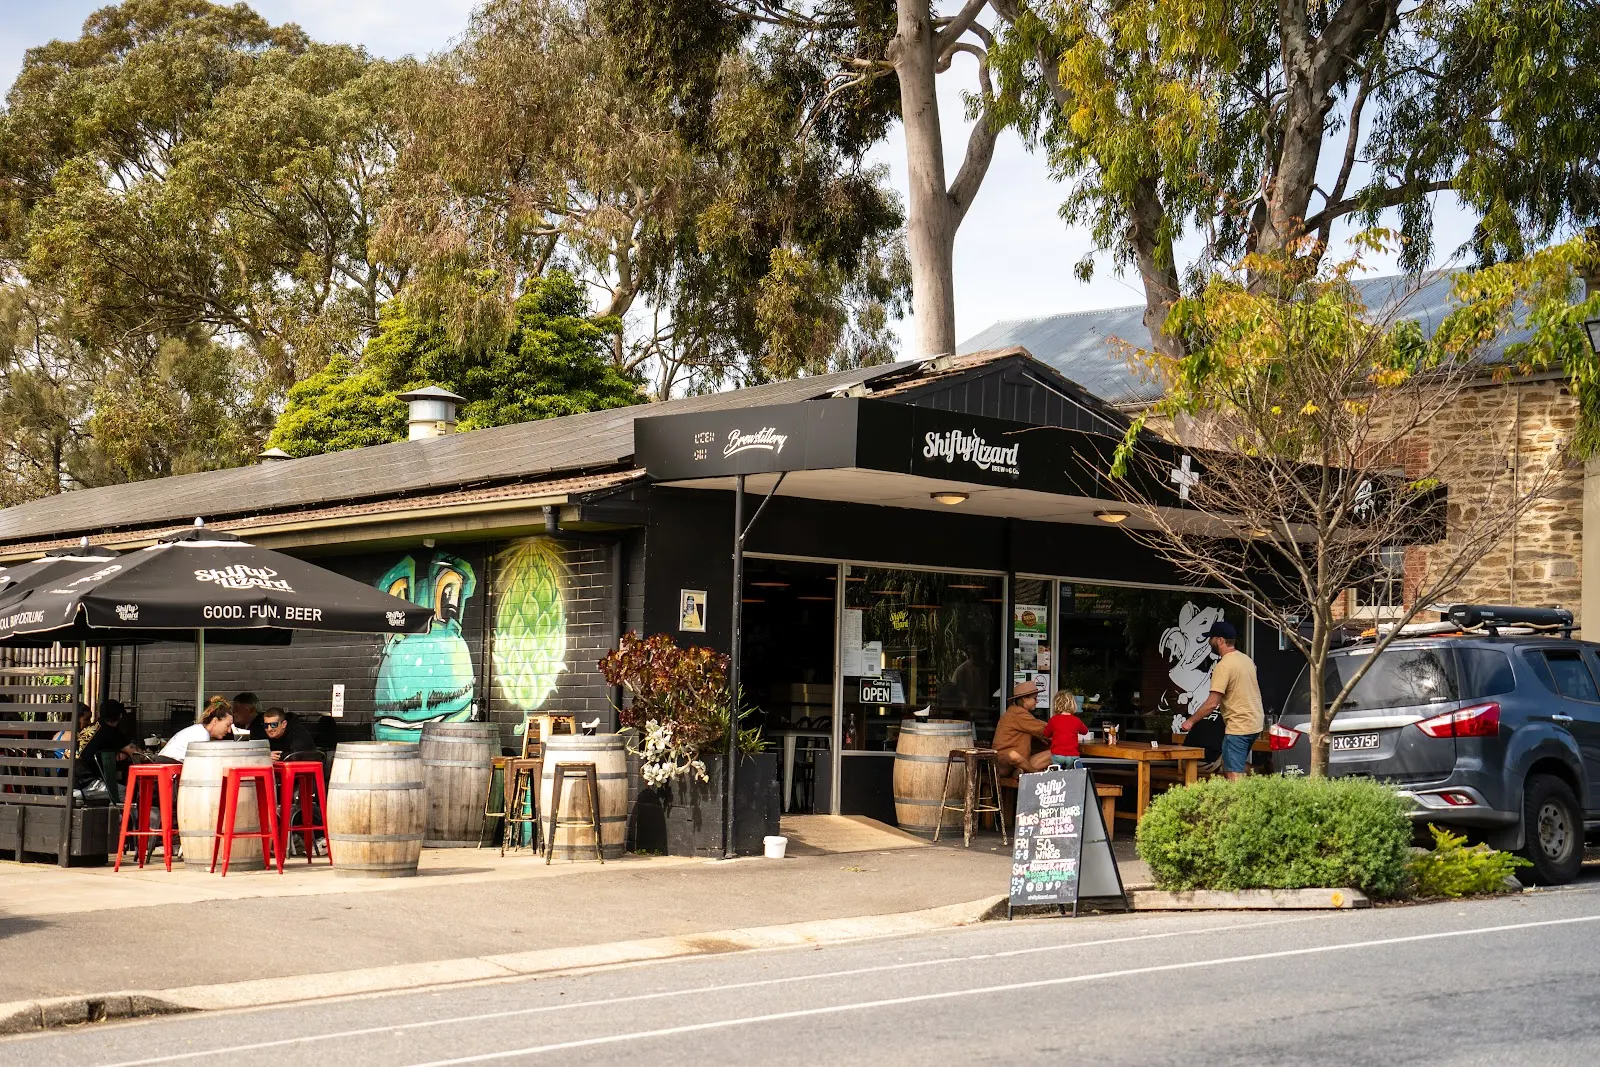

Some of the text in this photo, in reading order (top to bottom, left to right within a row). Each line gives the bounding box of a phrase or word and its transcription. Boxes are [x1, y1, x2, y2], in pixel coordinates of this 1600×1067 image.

[723, 426, 788, 454] Brewstillery
[193, 564, 278, 582] Shifty
[214, 576, 293, 590] Lizard
[203, 604, 322, 622] GOOD. FUN. BEER
[863, 687, 890, 702] OPEN
[1034, 777, 1066, 796] Shifty
[1038, 791, 1066, 808] Lizard
[1039, 805, 1081, 818] HAPPY HOURS
[1018, 826, 1034, 837] 5-7
[1014, 838, 1029, 850] FRI
[1014, 849, 1029, 861] 5-8
[1035, 848, 1061, 860] WINGS
[1012, 862, 1030, 876] SAT
[1010, 885, 1023, 896] 5-7
